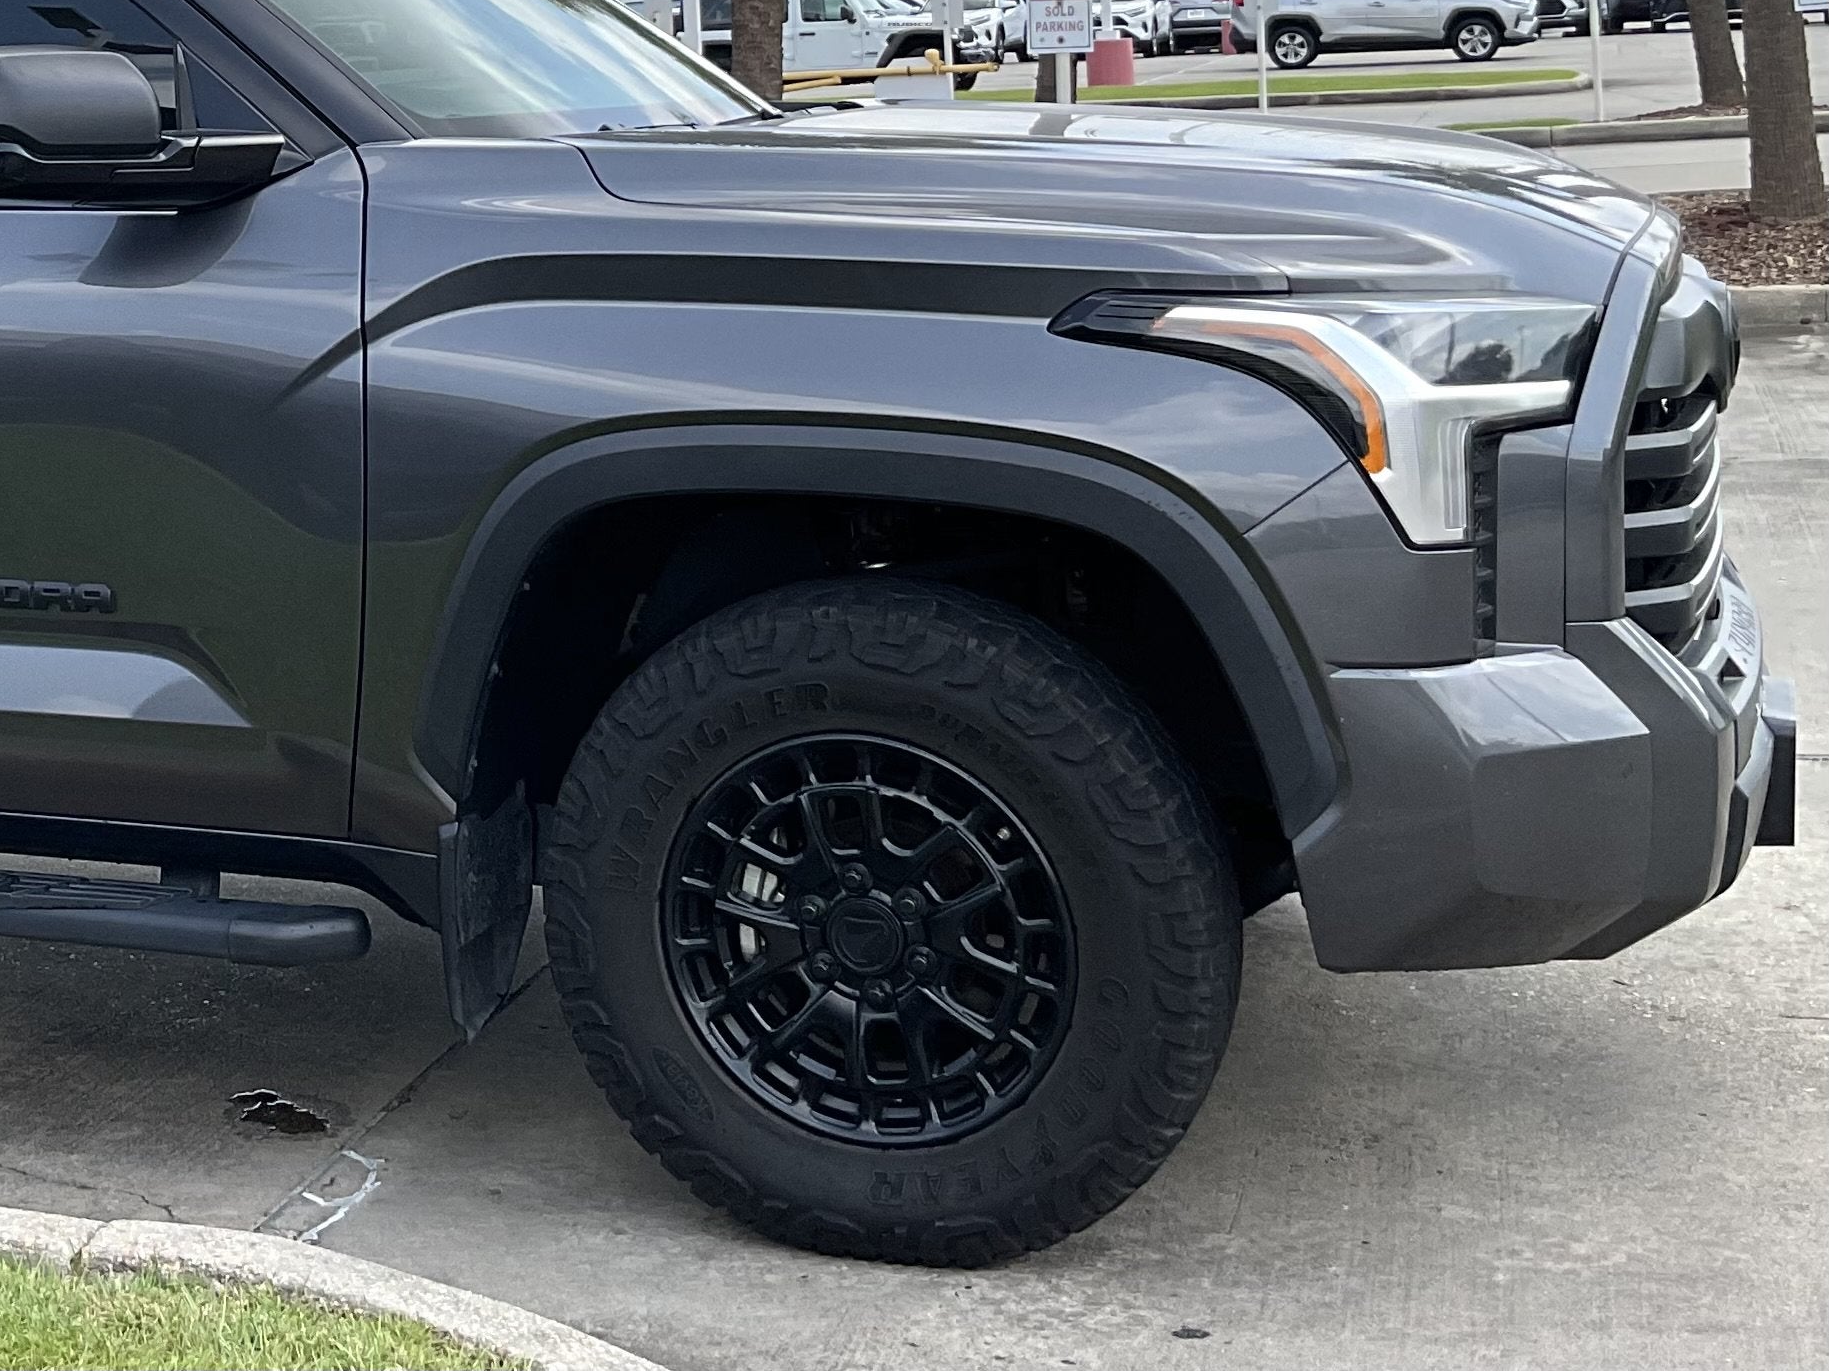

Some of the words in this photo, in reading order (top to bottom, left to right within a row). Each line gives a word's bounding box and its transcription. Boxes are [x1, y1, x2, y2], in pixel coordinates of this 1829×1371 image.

[1035, 21, 1084, 32] PARKING
[1045, 6, 1075, 17] SOLD
[604, 682, 833, 893] WRANGLER
[866, 976, 1130, 1206] GOODYEAR
